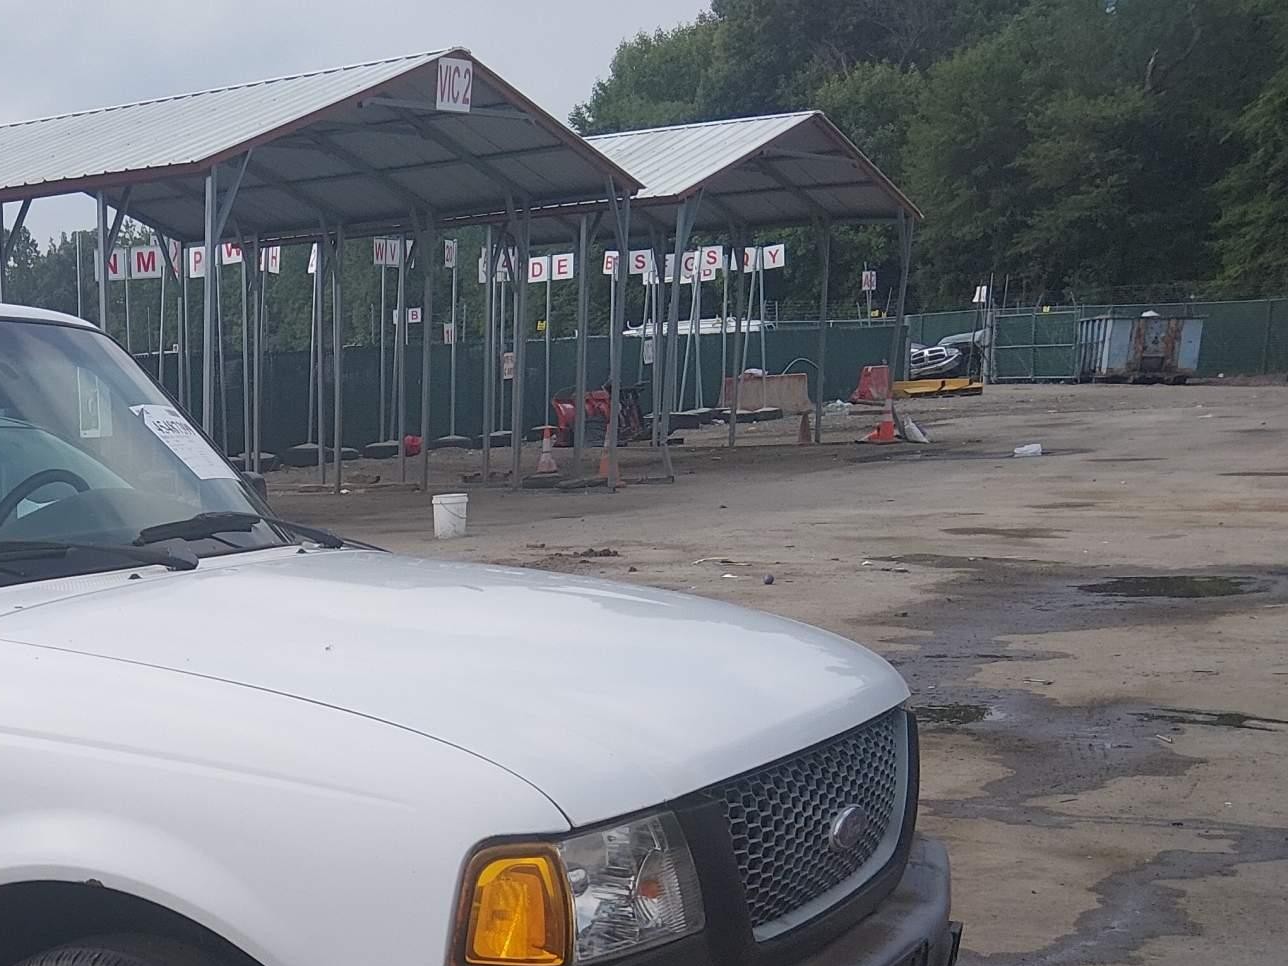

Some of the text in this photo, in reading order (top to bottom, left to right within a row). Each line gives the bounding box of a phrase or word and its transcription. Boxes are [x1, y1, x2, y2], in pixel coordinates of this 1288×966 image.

[439, 64, 471, 104] VIC 2
[375, 243, 384, 261] W
[390, 244, 396, 261] V
[706, 250, 717, 265] S
[768, 249, 779, 264] Y
[136, 250, 156, 273] M
[193, 251, 202, 272] P
[557, 259, 567, 275] E
[634, 254, 646, 269] S
[531, 262, 543, 278] D
[411, 310, 419, 320] B
